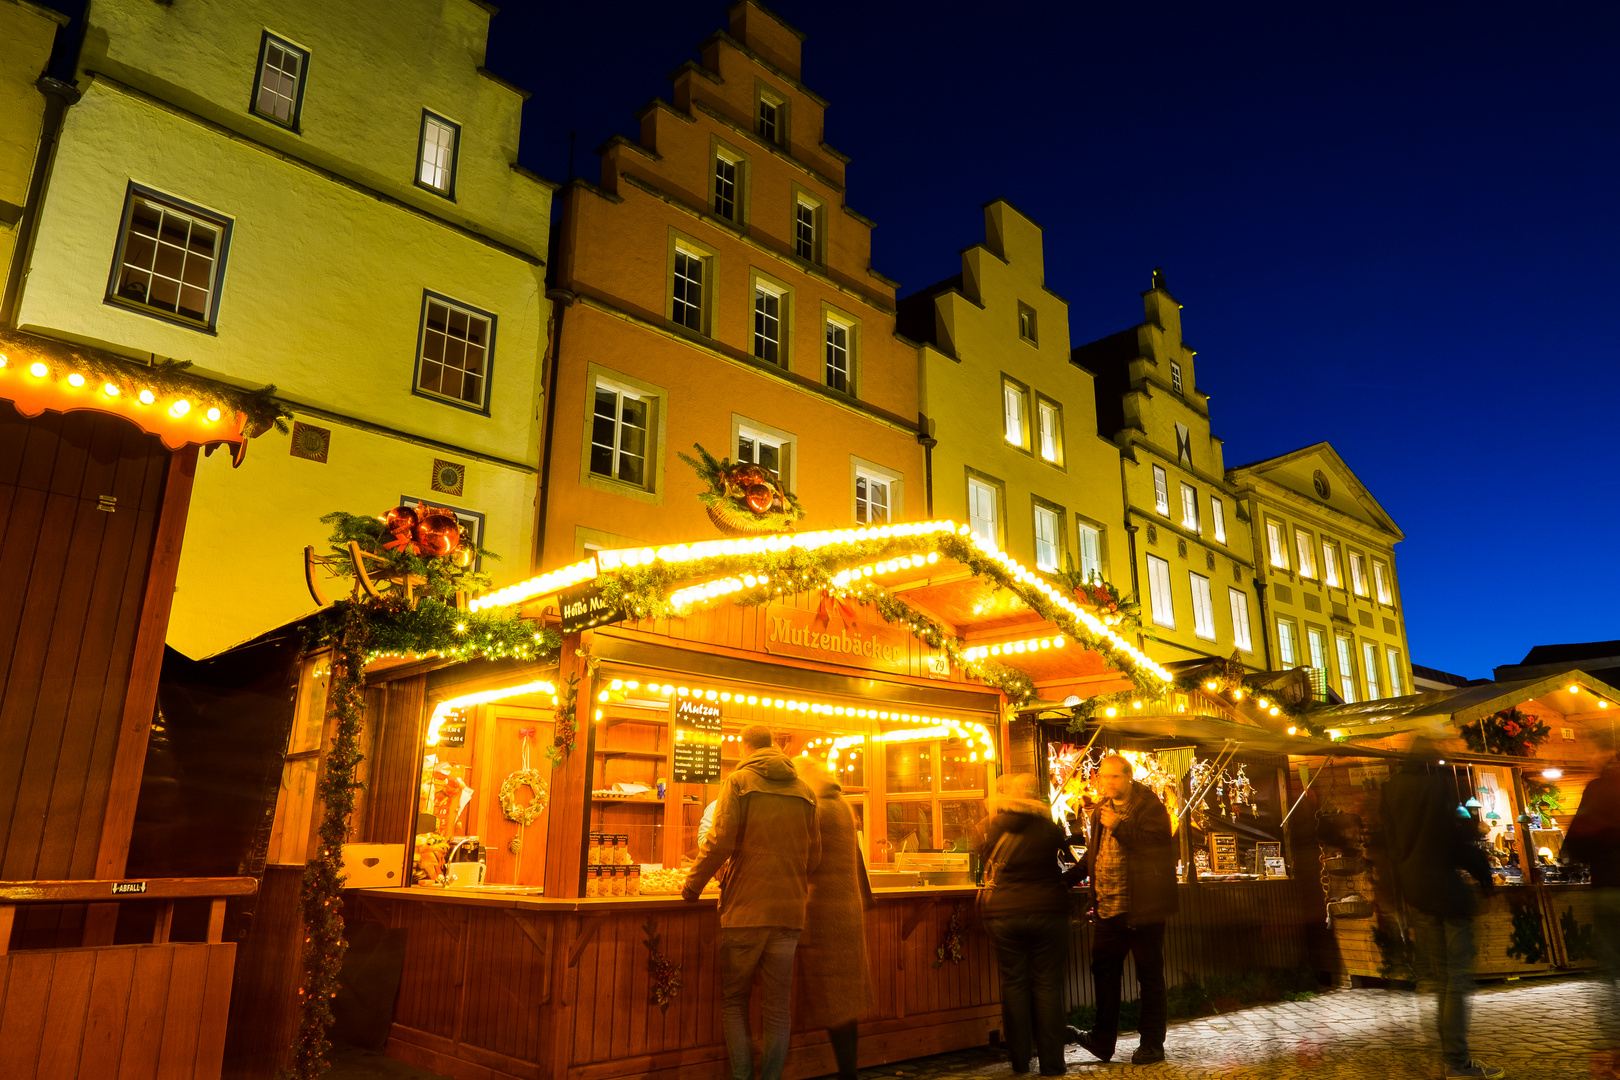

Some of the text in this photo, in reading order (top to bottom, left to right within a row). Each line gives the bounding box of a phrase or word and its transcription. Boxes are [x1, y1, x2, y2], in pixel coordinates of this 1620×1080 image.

[564, 601, 588, 619] Heiße
[769, 616, 901, 661] Mutzenbäcker
[935, 659, 945, 672] 79
[679, 701, 720, 717] Mutzen
[1564, 729, 1571, 738] 77
[119, 884, 140, 892] ABFALL
